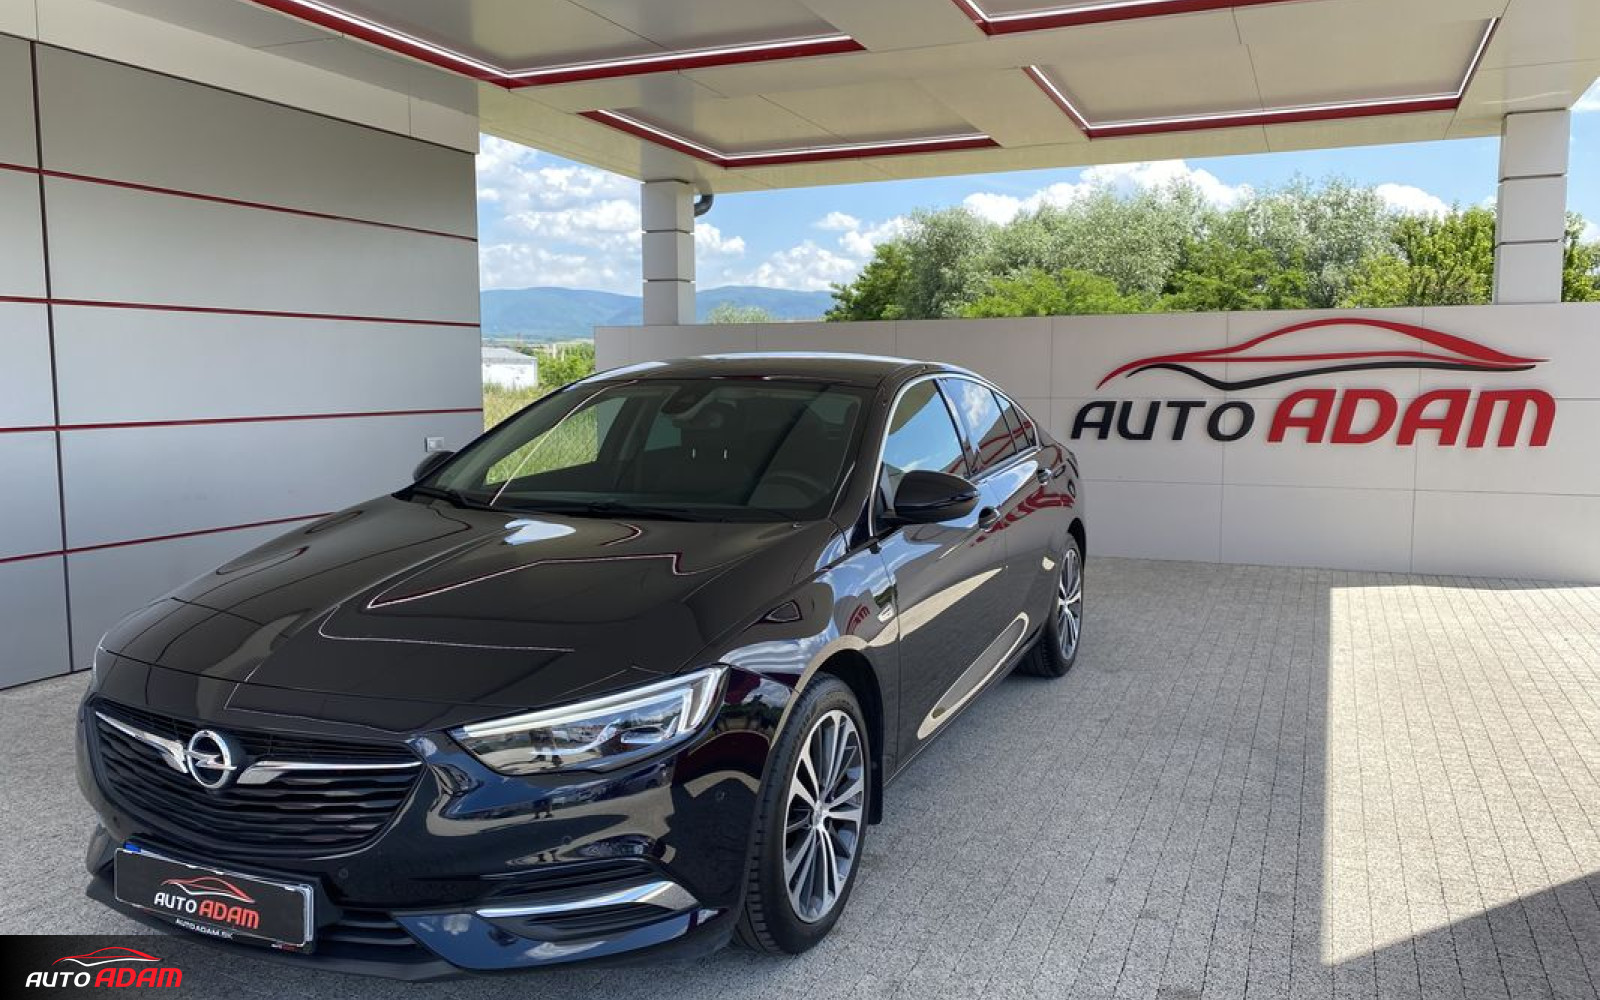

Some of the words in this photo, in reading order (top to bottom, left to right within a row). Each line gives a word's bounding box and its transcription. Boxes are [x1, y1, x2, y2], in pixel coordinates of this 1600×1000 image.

[1070, 399, 1255, 442] AUTO
[1266, 387, 1557, 448] ADAM
[154, 892, 197, 914] AUTO
[198, 900, 259, 929] ADAM
